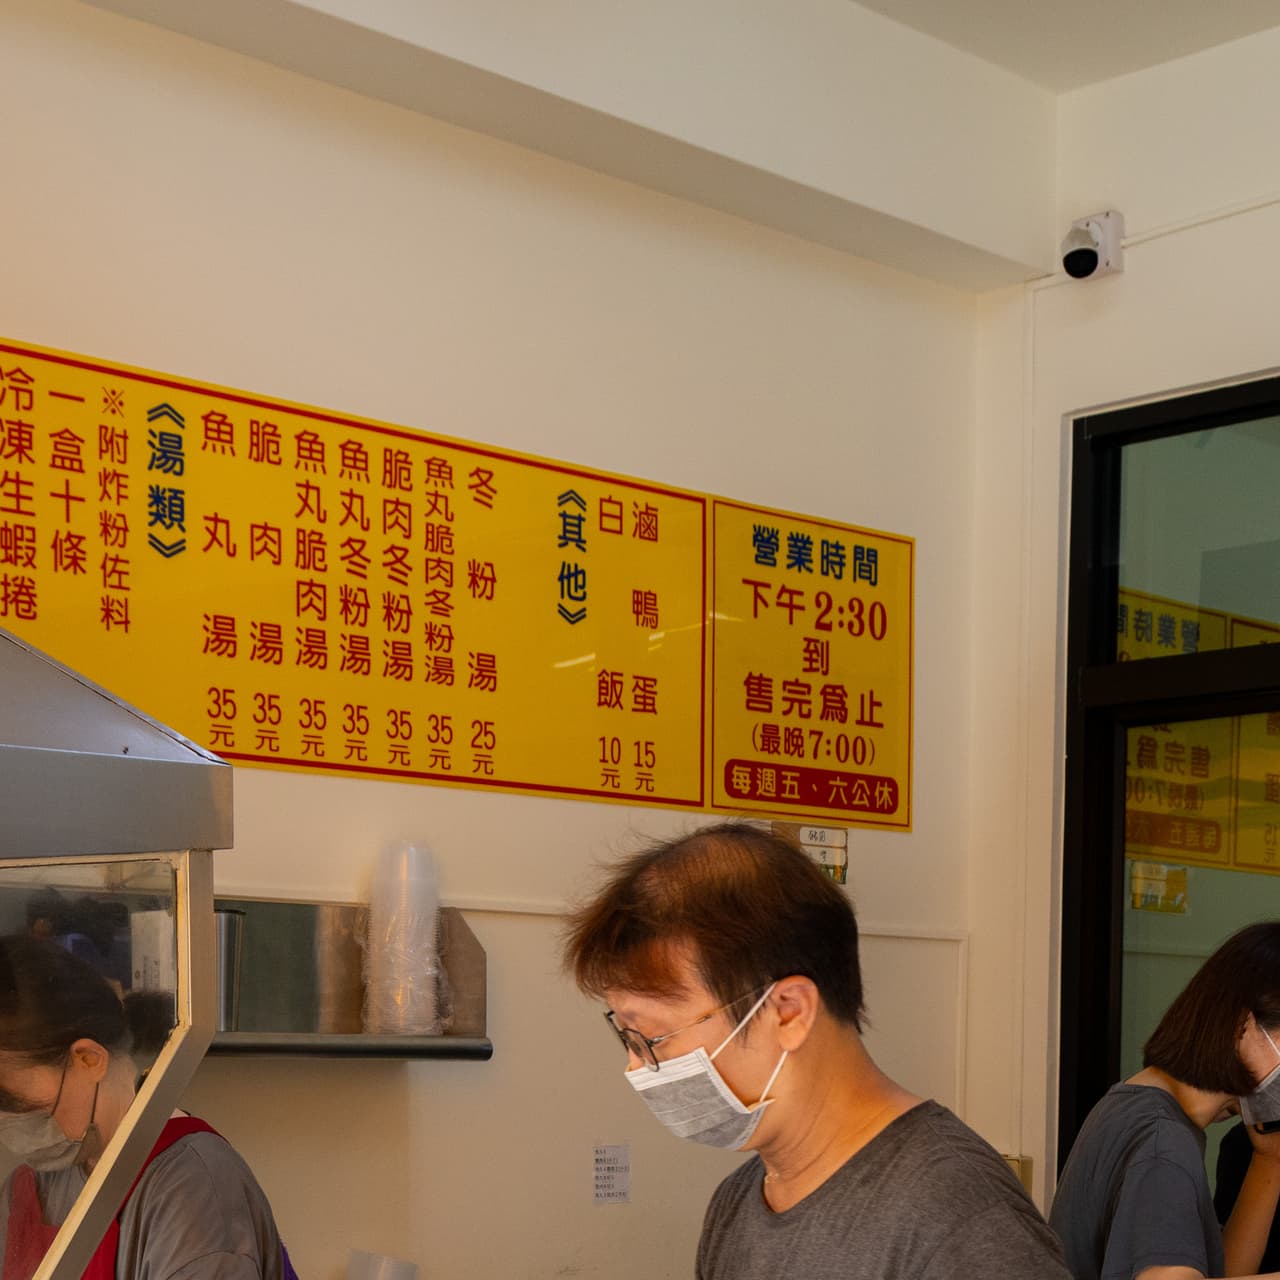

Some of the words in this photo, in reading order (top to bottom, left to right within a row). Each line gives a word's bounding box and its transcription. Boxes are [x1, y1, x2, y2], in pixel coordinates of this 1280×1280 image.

[49, 392, 86, 574] 一盒十條
[202, 411, 237, 658] 魚丸湯
[249, 420, 283, 665] 脆肉湯
[295, 430, 327, 670] 魚丸脆肉湯
[339, 440, 371, 675] 魚丸冬粉湯
[382, 448, 413, 681] 脆肉冬粉湯
[425, 457, 454, 686] 魚丸脆肉冬粉湯
[468, 468, 497, 692] 冬粉湯
[752, 524, 878, 587] 營業時間
[597, 496, 623, 710] 白飯
[632, 503, 658, 714] 滷鴨蛋
[802, 636, 830, 676] 到
[731, 765, 894, 810] 每週五、六公休
